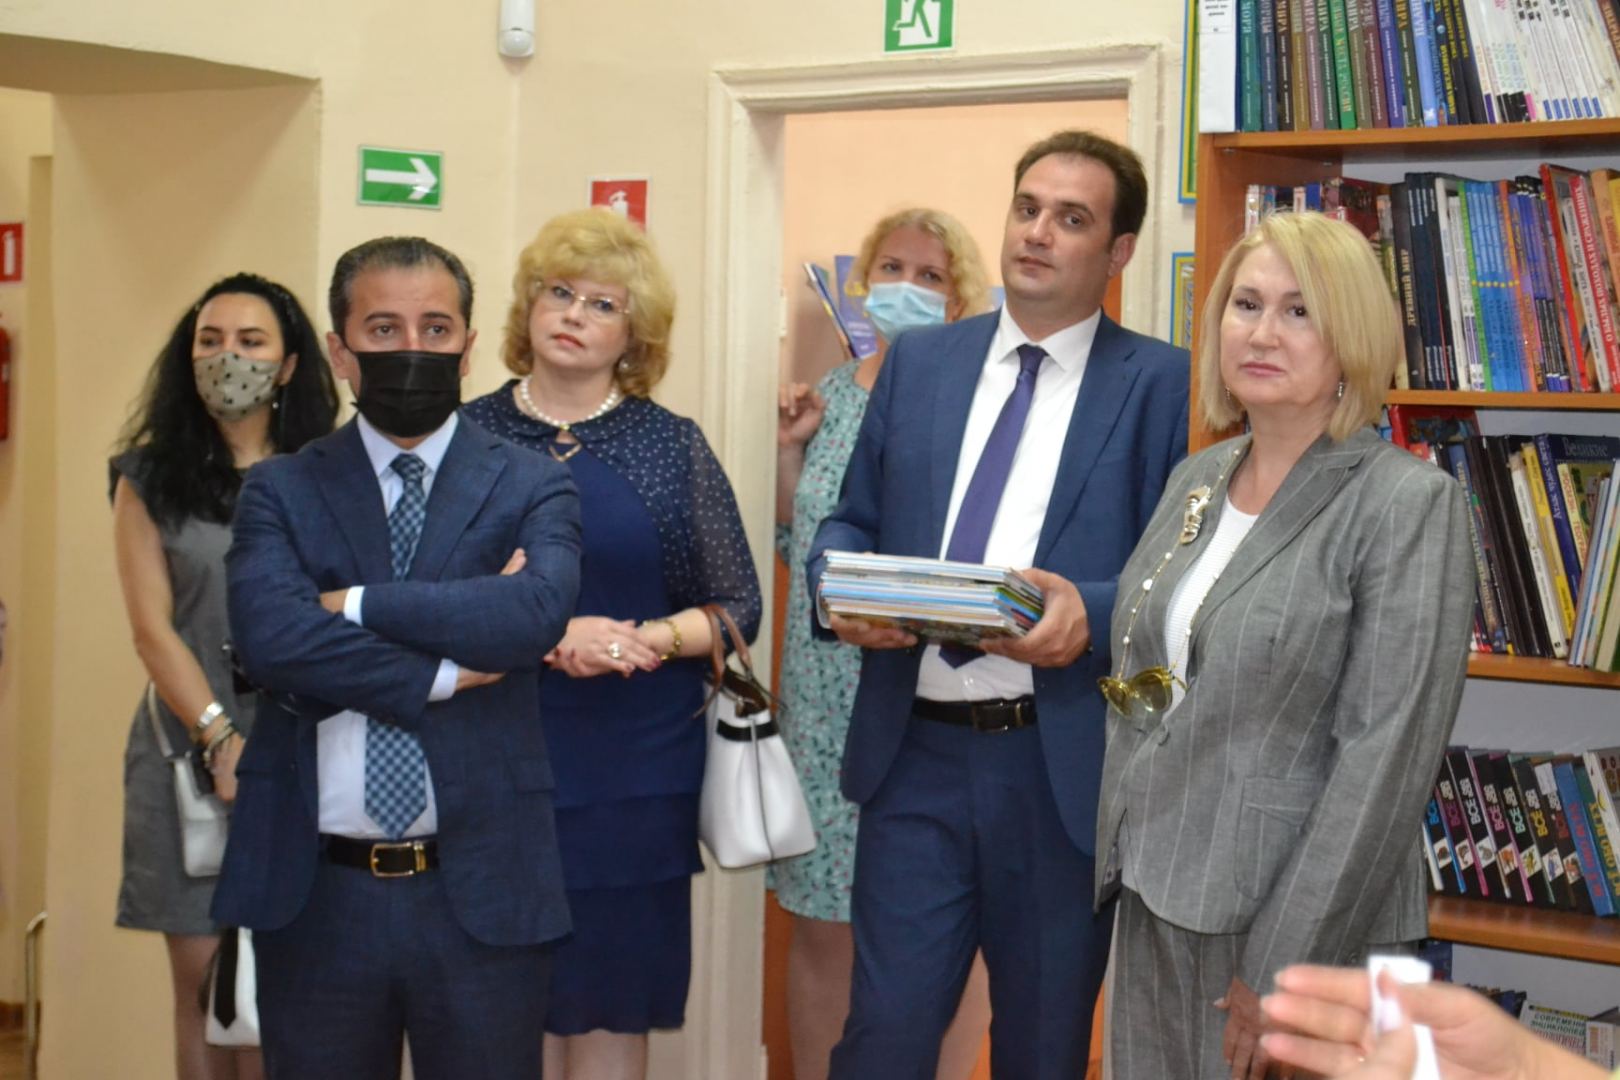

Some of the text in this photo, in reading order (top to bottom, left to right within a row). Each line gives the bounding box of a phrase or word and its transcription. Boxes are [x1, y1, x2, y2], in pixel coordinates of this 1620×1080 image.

[1261, 0, 1273, 33] ОРЦЫ
[1395, 0, 1408, 28] ИРА
[1411, 0, 1424, 36] ПЛАН
[1400, 247, 1417, 326] ДРЕВНИЙ МИР
[1588, 252, 1606, 298] ПОХОДАХ
[1466, 799, 1481, 825] ВСЕ
[1488, 804, 1505, 831] ВСЕ
[1510, 807, 1526, 834] ВСЕ
[1530, 810, 1549, 837] ВСЕ
[1530, 1020, 1586, 1036] ЭНЦИКЛОПЕД
[1534, 1012, 1586, 1027] СОВРЕМЕНН
